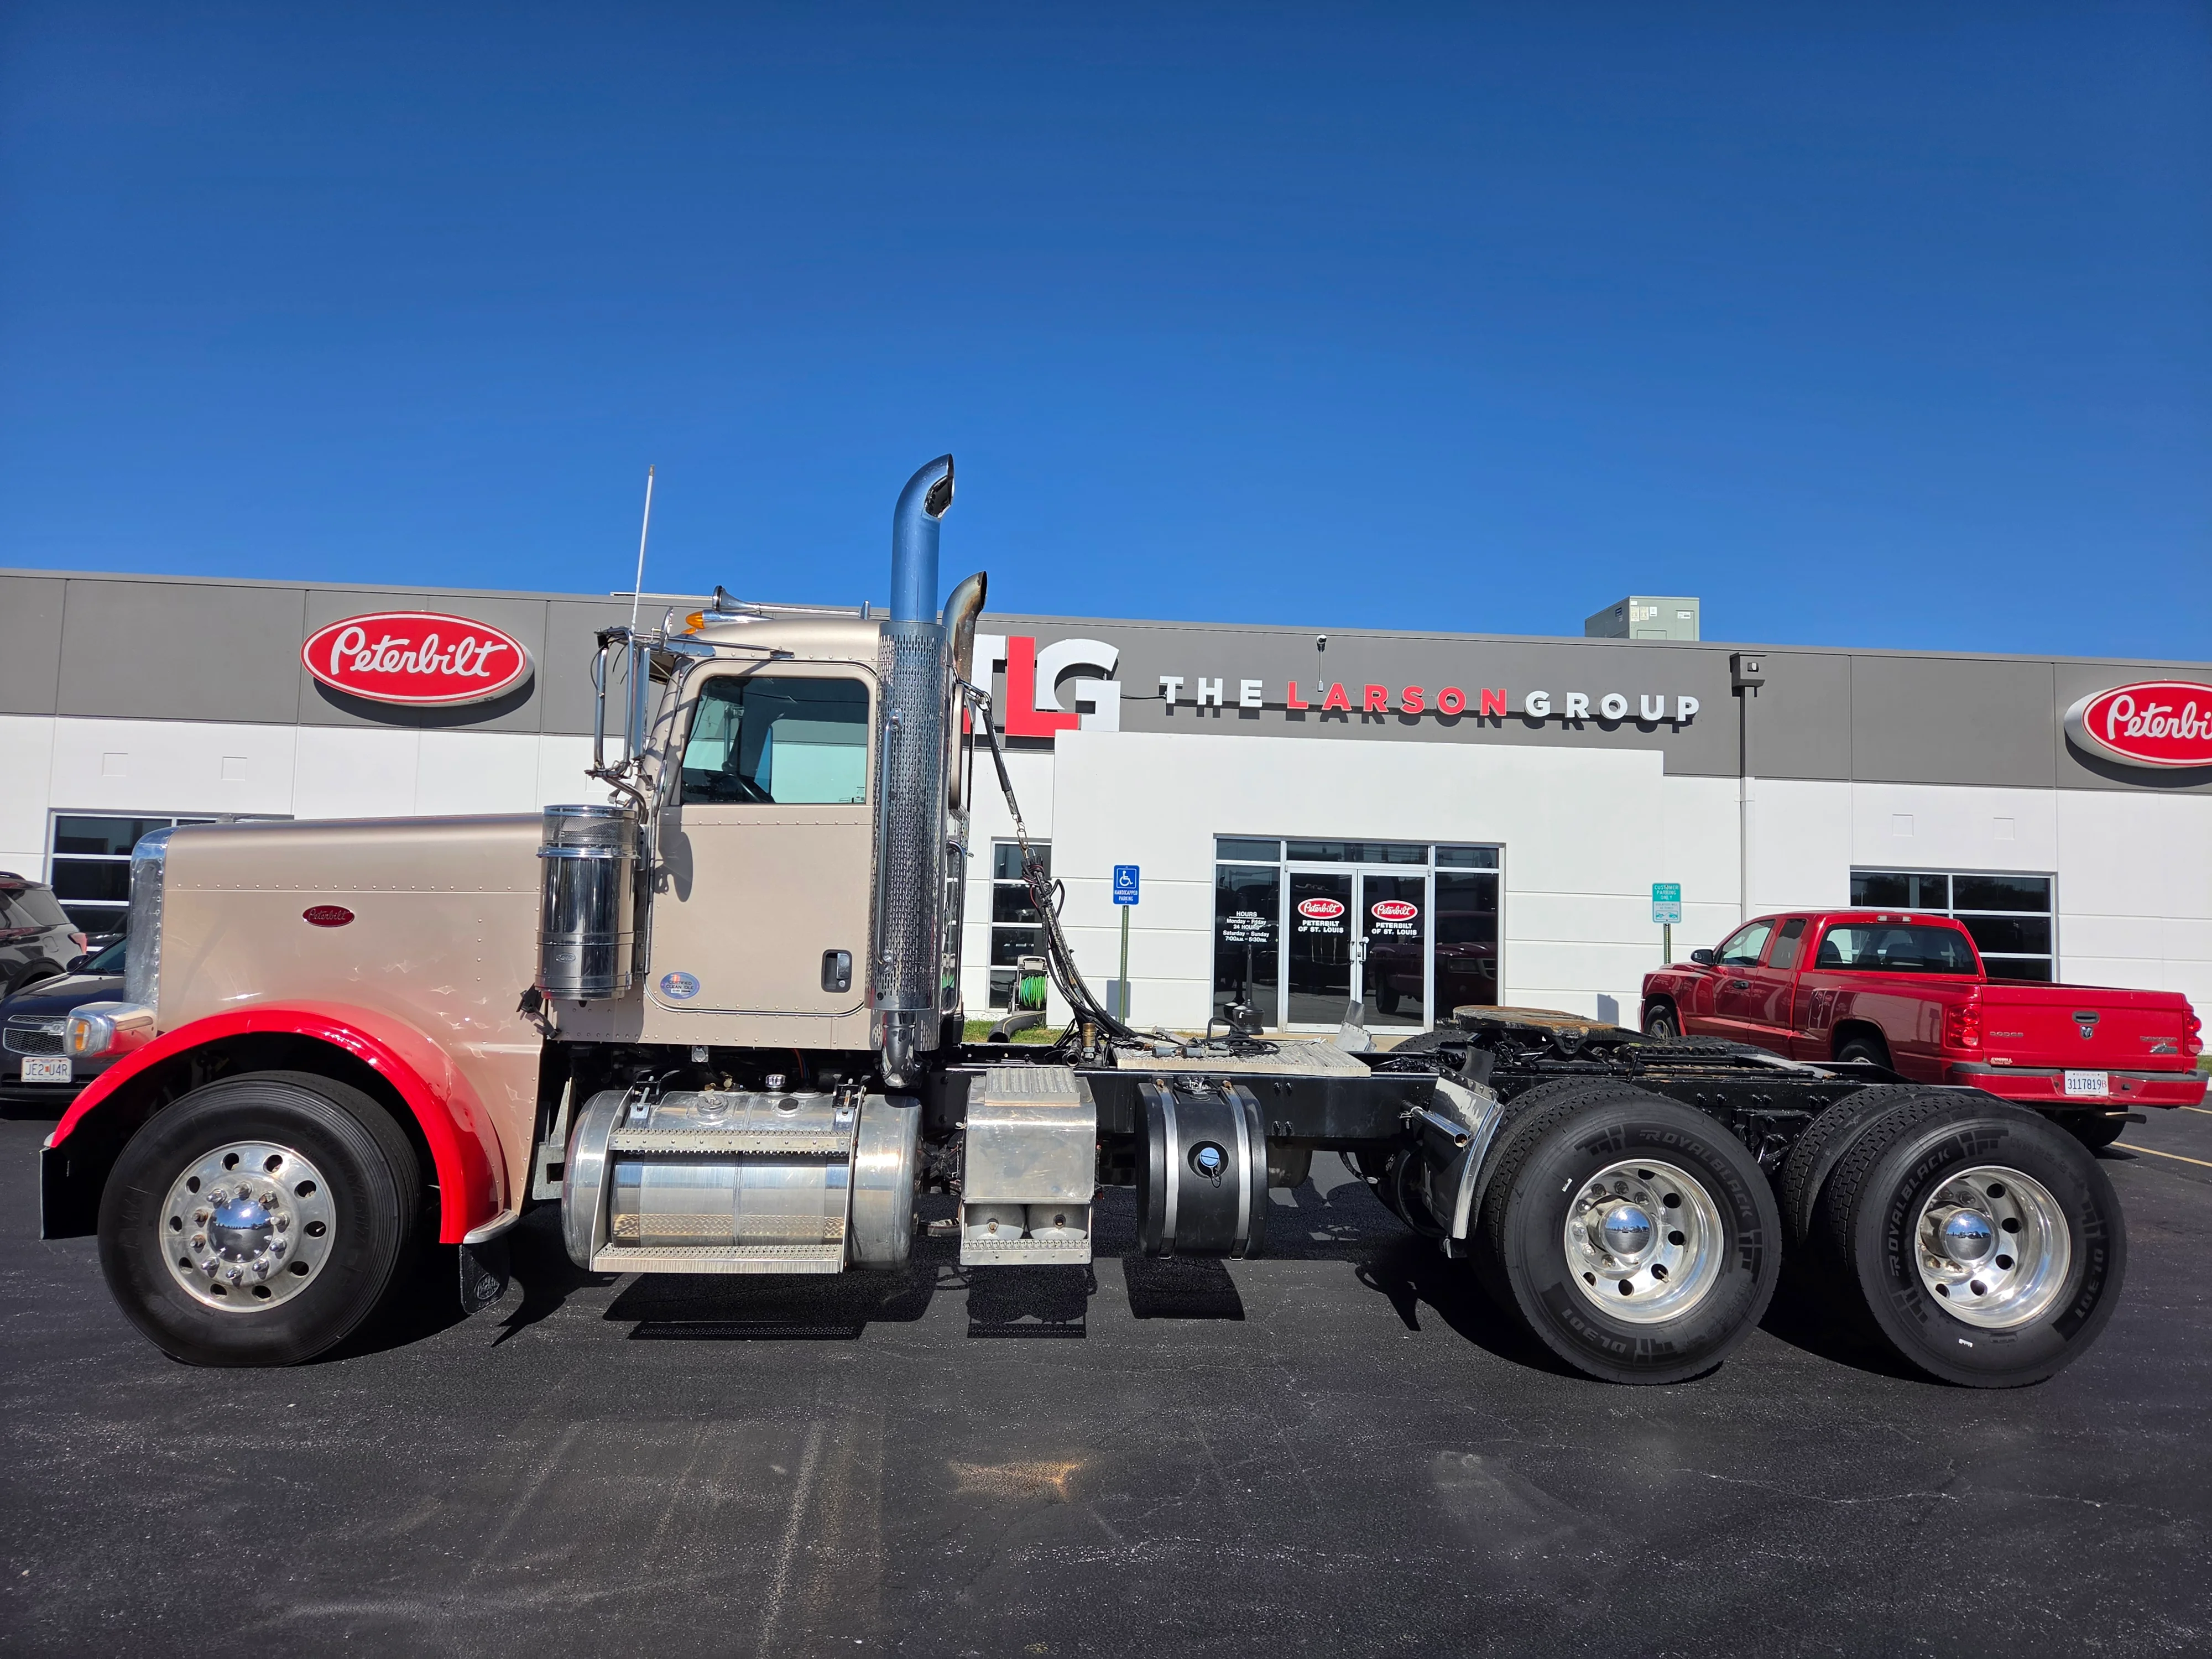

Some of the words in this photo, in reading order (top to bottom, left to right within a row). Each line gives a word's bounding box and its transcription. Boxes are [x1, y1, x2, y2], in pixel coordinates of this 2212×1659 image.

[331, 626, 508, 677] Peterbilt
[1159, 675, 1263, 707] THE
[1286, 680, 1507, 717] LARSON
[1524, 690, 1700, 722] GROUP
[2107, 694, 2212, 740] Peterbi
[308, 909, 350, 921] Peterbilt
[1303, 901, 1340, 913] Peterbilt
[1377, 904, 1413, 916] Peterbilt
[25, 1063, 44, 1076] JE2
[49, 1063, 67, 1076] U4R
[1561, 1308, 1627, 1354] DL301
